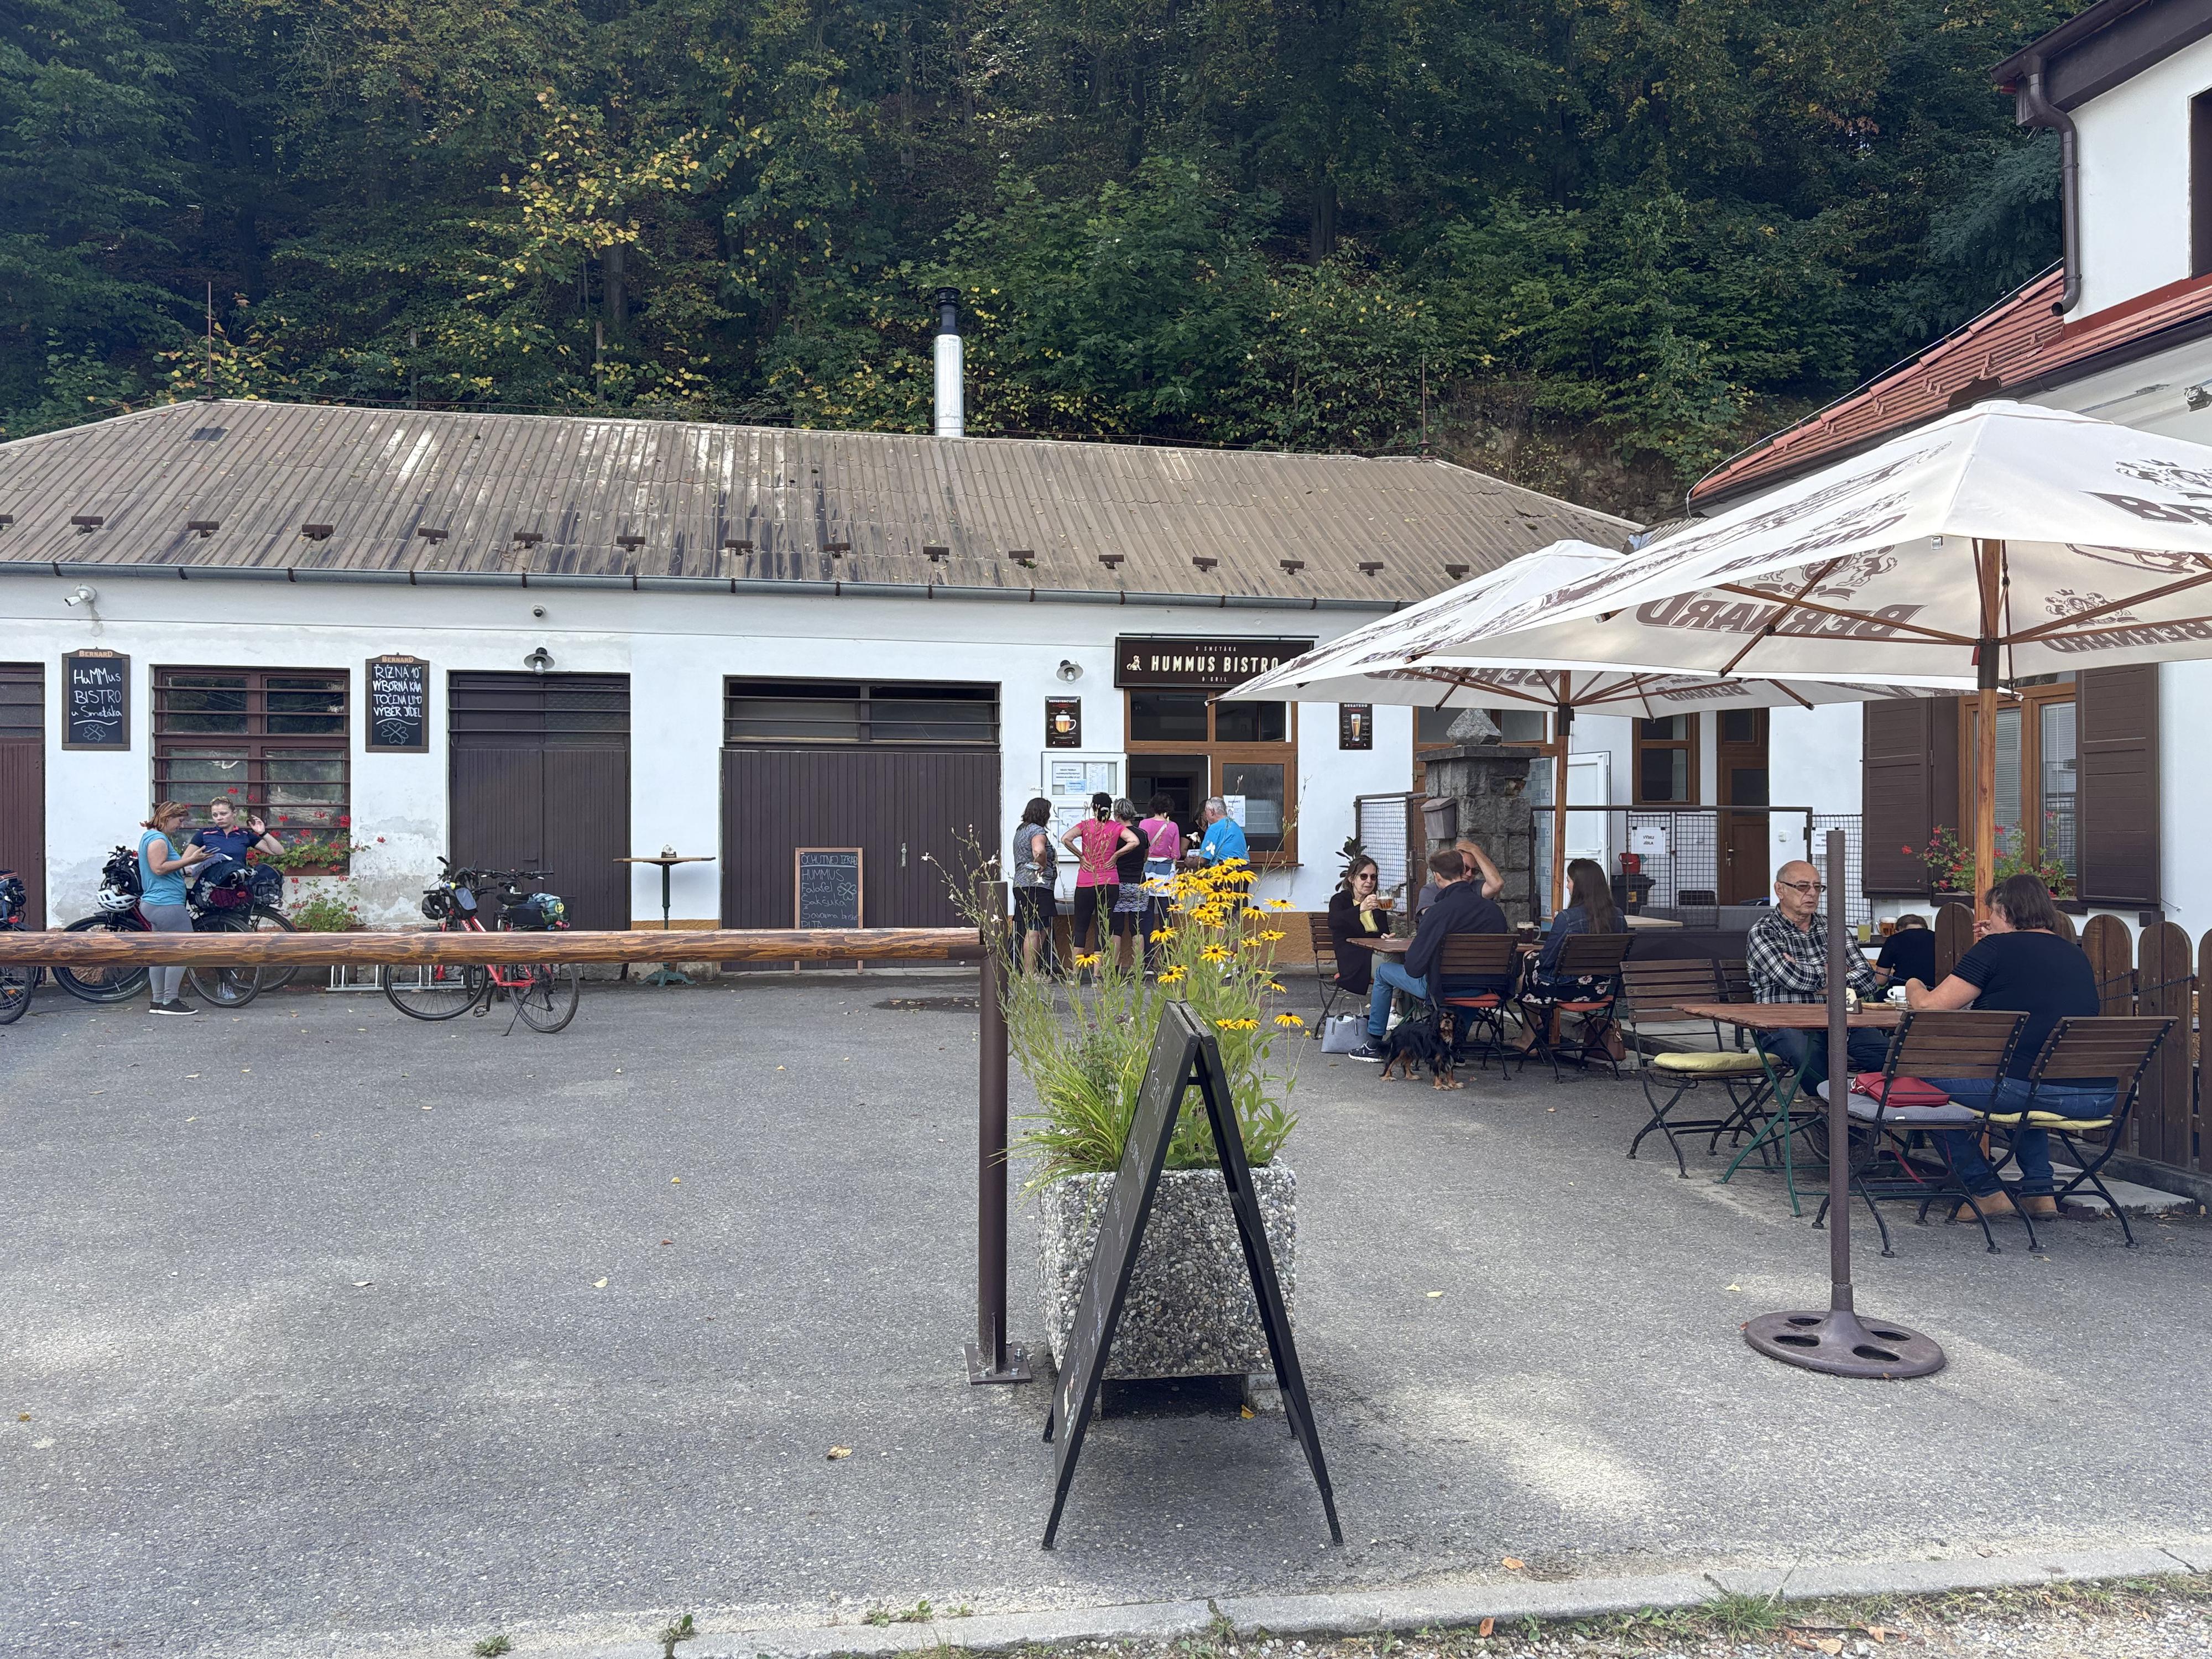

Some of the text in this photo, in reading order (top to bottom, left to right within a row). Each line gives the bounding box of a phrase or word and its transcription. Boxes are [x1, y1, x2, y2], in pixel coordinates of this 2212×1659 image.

[1150, 655, 1279, 673] HUMMUS BISTRO
[74, 690, 121, 704] BISTRO
[801, 869, 844, 881] HUMMUS
[802, 881, 833, 893] Falafel
